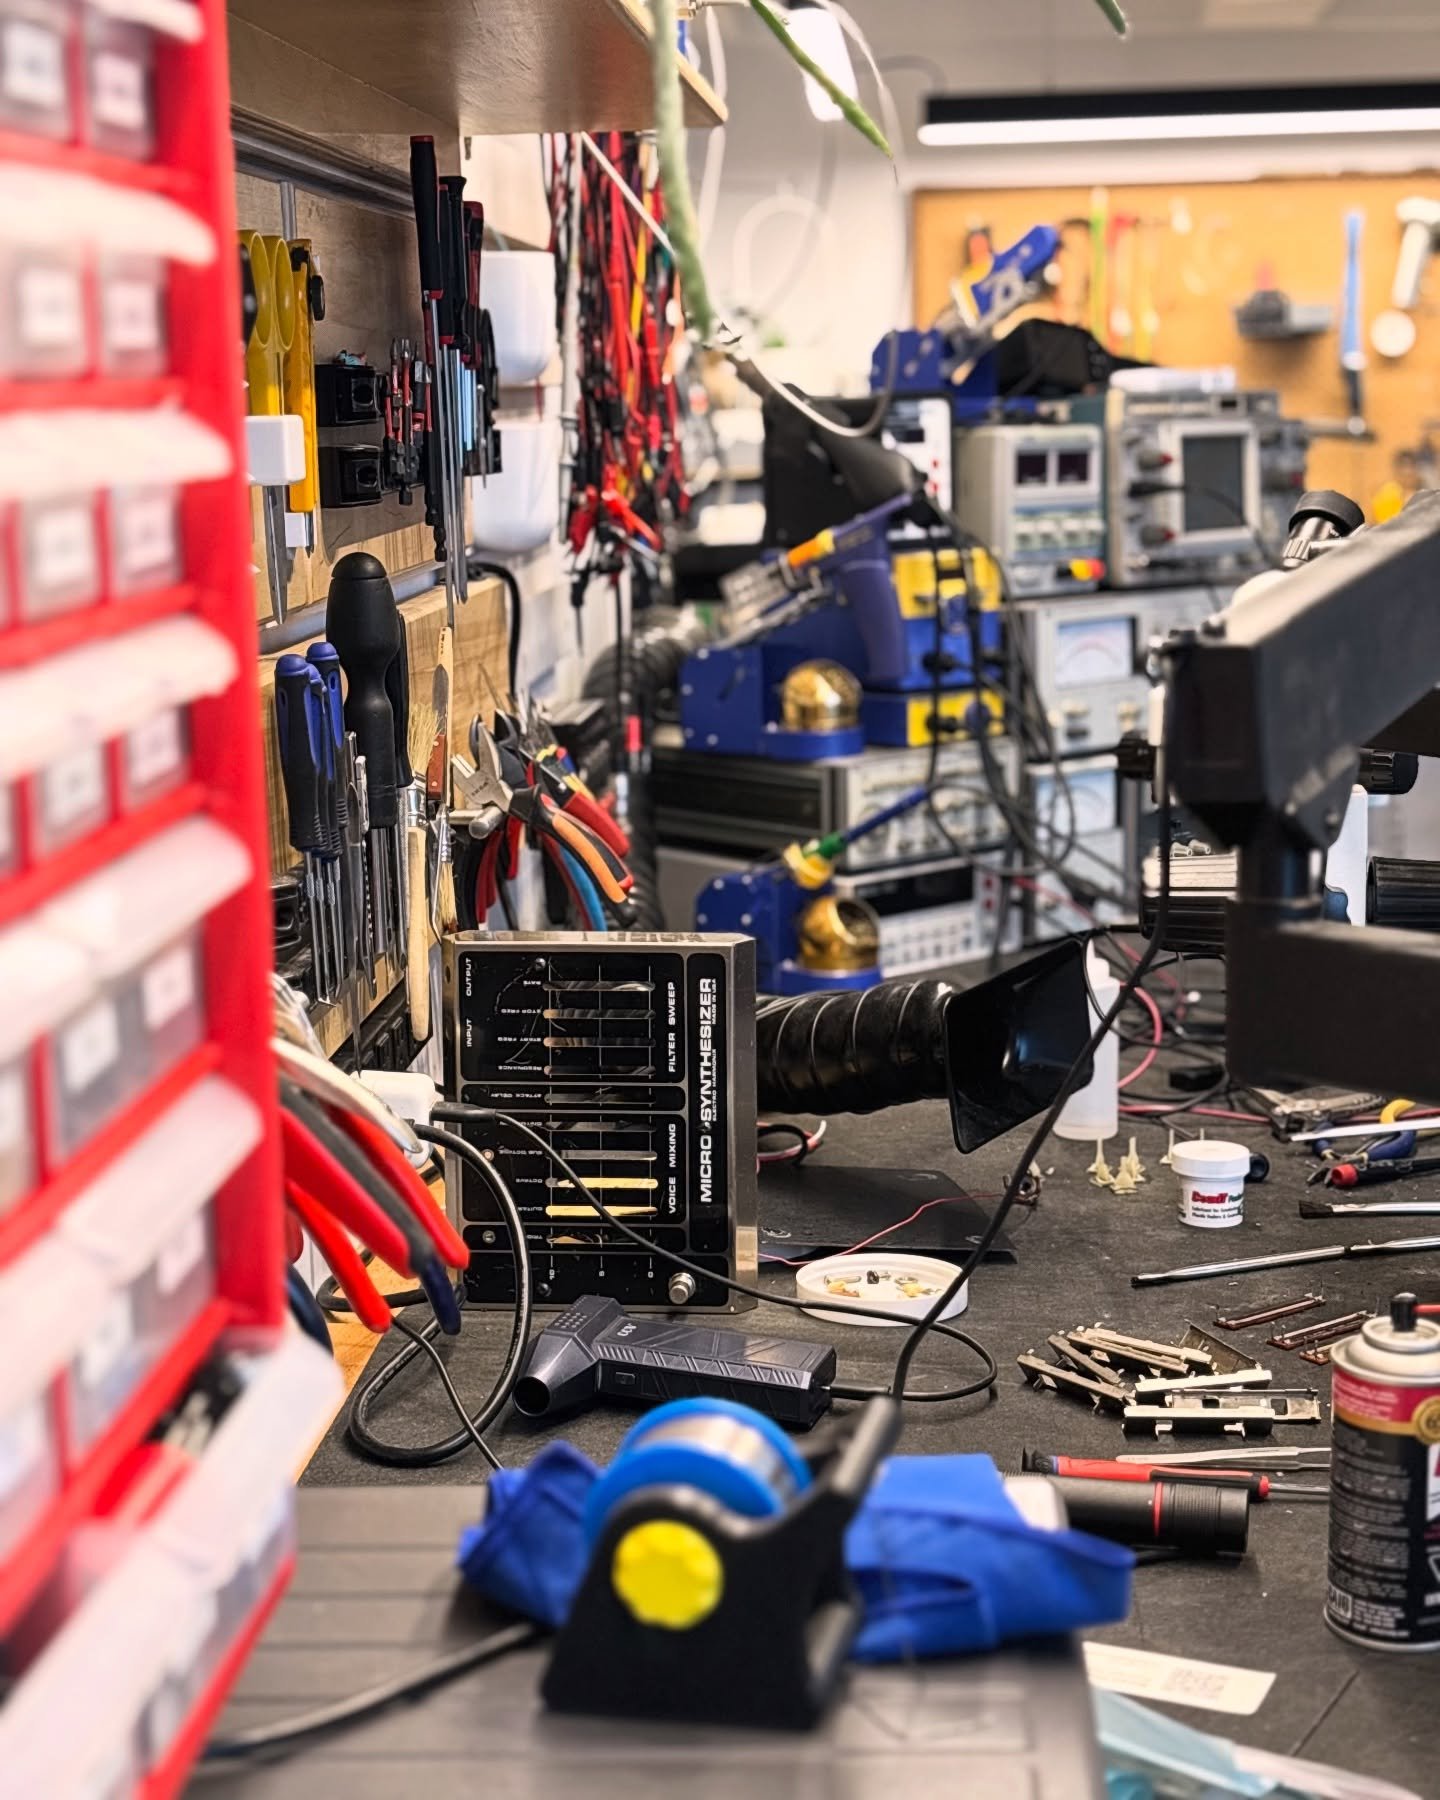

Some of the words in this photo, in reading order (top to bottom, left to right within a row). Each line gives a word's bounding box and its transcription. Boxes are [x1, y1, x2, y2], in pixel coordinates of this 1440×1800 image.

[667, 981, 675, 1026] SWEEP
[667, 1032, 676, 1073] FILTER
[699, 977, 712, 1122] SYNTHESIZER
[668, 1123, 677, 1168] MIXING
[699, 1134, 712, 1203] MICRO
[668, 1176, 677, 1215] VOICE
[549, 1269, 555, 1280] 10
